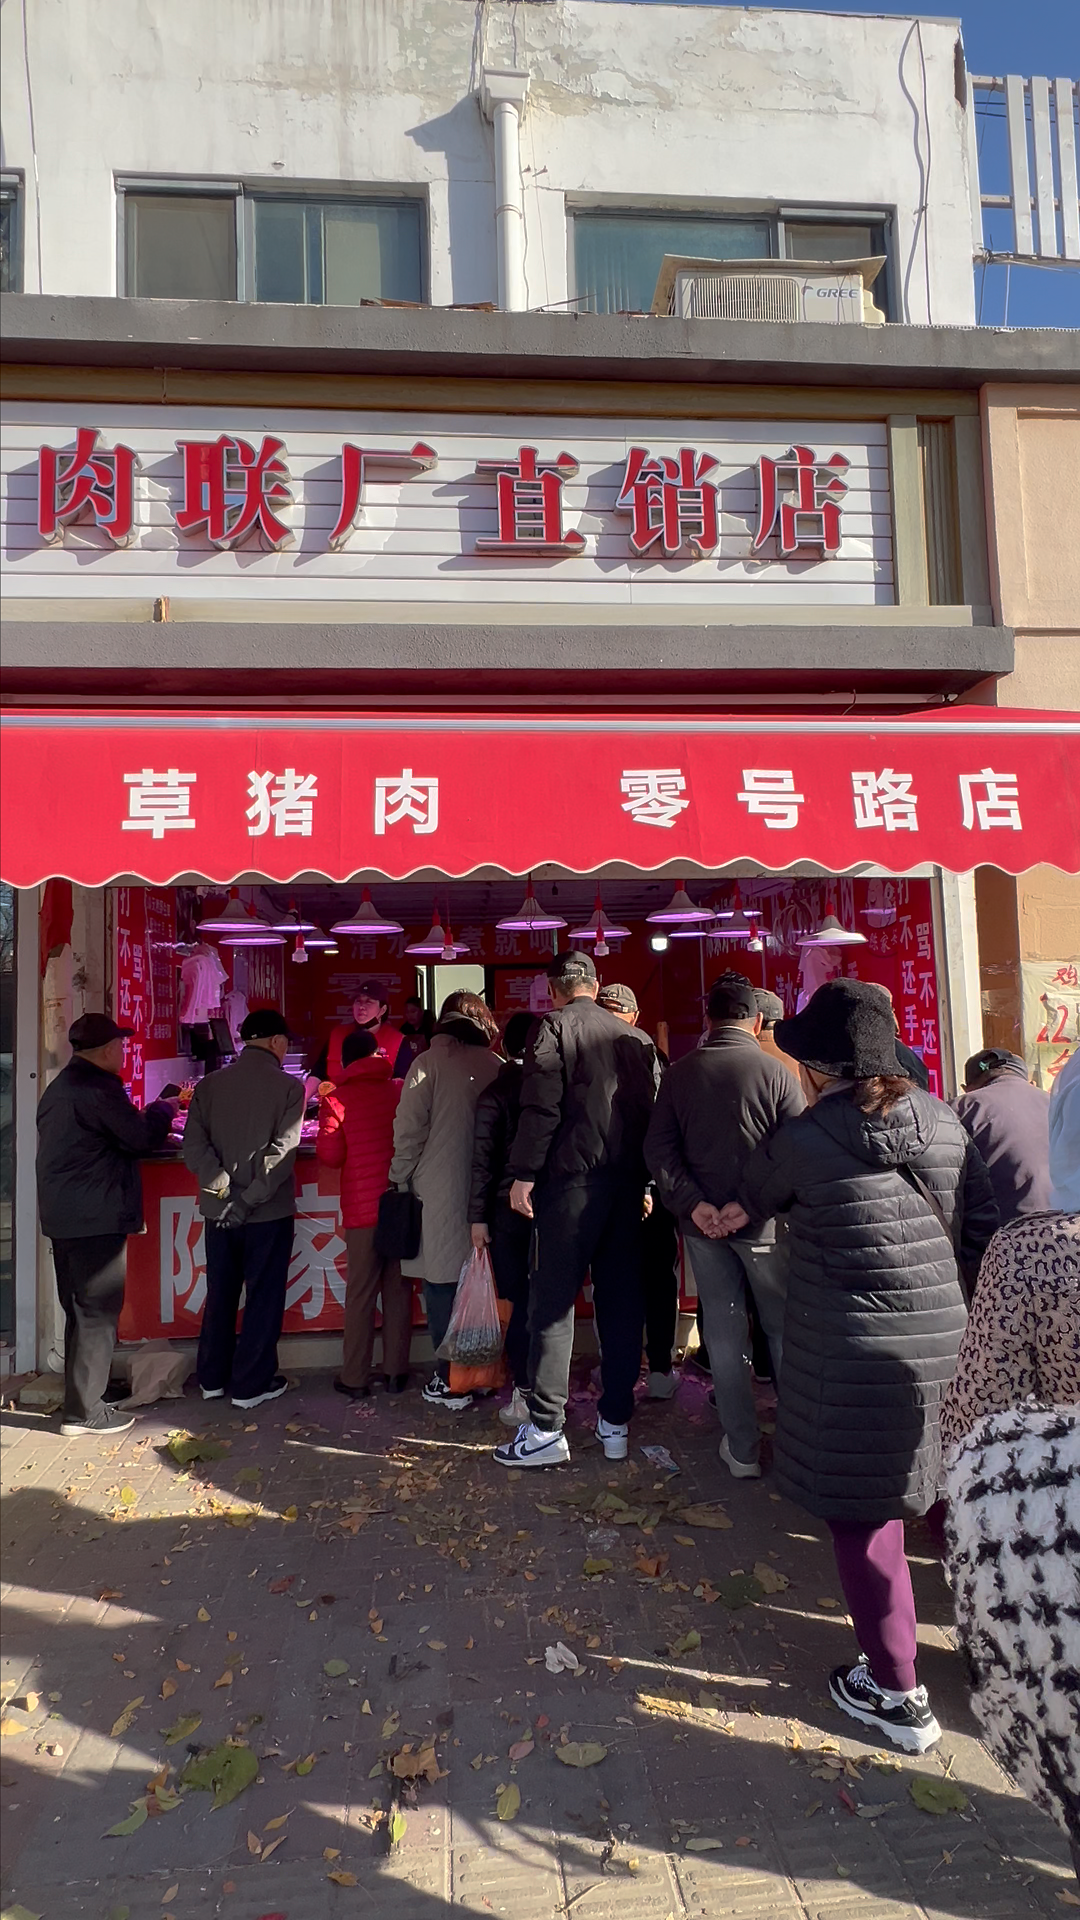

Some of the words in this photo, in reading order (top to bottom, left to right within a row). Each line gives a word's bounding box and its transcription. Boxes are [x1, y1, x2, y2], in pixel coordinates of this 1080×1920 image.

[816, 286, 859, 299] GREE
[38, 427, 851, 554] 肉联厂直销店
[122, 768, 438, 839] 草猪肉
[620, 768, 1022, 832] 零号路店
